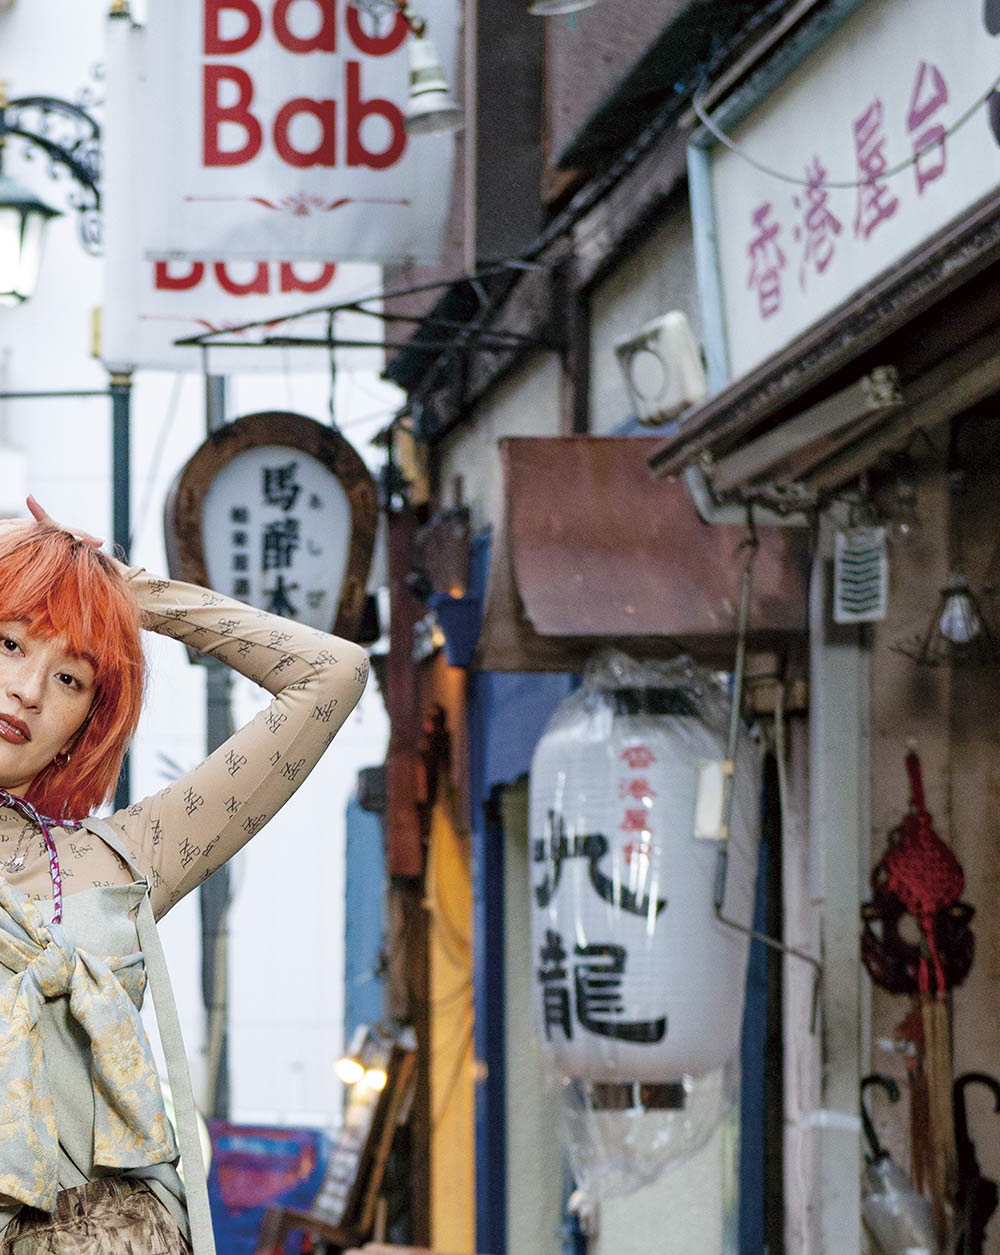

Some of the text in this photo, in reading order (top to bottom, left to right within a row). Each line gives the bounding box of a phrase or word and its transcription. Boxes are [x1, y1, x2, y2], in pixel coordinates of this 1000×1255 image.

[202, 61, 408, 170] Bab
[748, 60, 950, 322] 香港屋台
